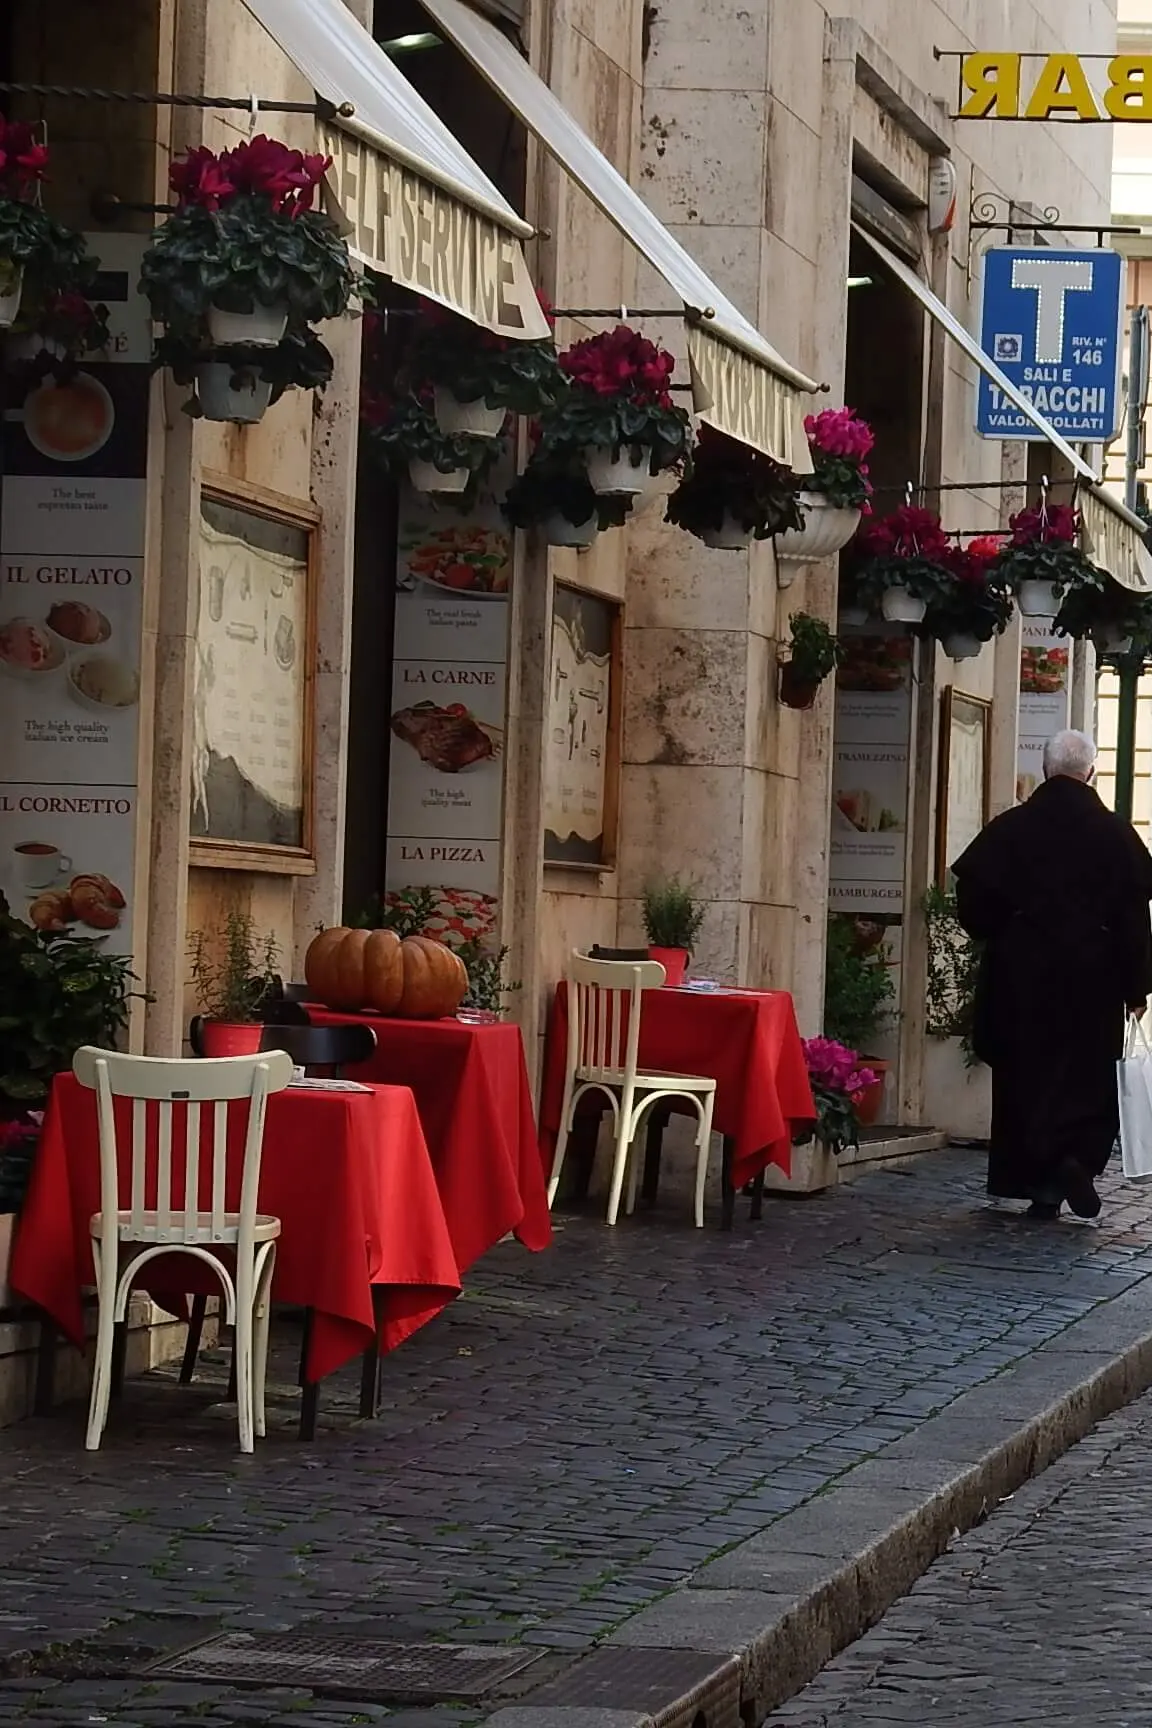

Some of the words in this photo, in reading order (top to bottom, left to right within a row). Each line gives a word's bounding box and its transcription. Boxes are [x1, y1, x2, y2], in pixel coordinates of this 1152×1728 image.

[400, 170, 525, 330] SERVICE
[1012, 259, 1093, 364] T
[1072, 336, 1092, 346] RIV.
[1072, 349, 1102, 365] 146
[1024, 367, 1056, 382] SALI
[1062, 368, 1073, 382] E
[6, 566, 29, 583] IL
[36, 566, 132, 586] GELATO
[404, 669, 426, 683] LA
[432, 669, 496, 685] CARNE
[24, 719, 45, 730] The
[48, 720, 71, 734] high
[73, 720, 110, 735] quality
[19, 796, 131, 814] CORNETTO
[401, 846, 424, 860] LA
[430, 847, 485, 862] PIZZA
[828, 887, 903, 898] HAMBURGER
